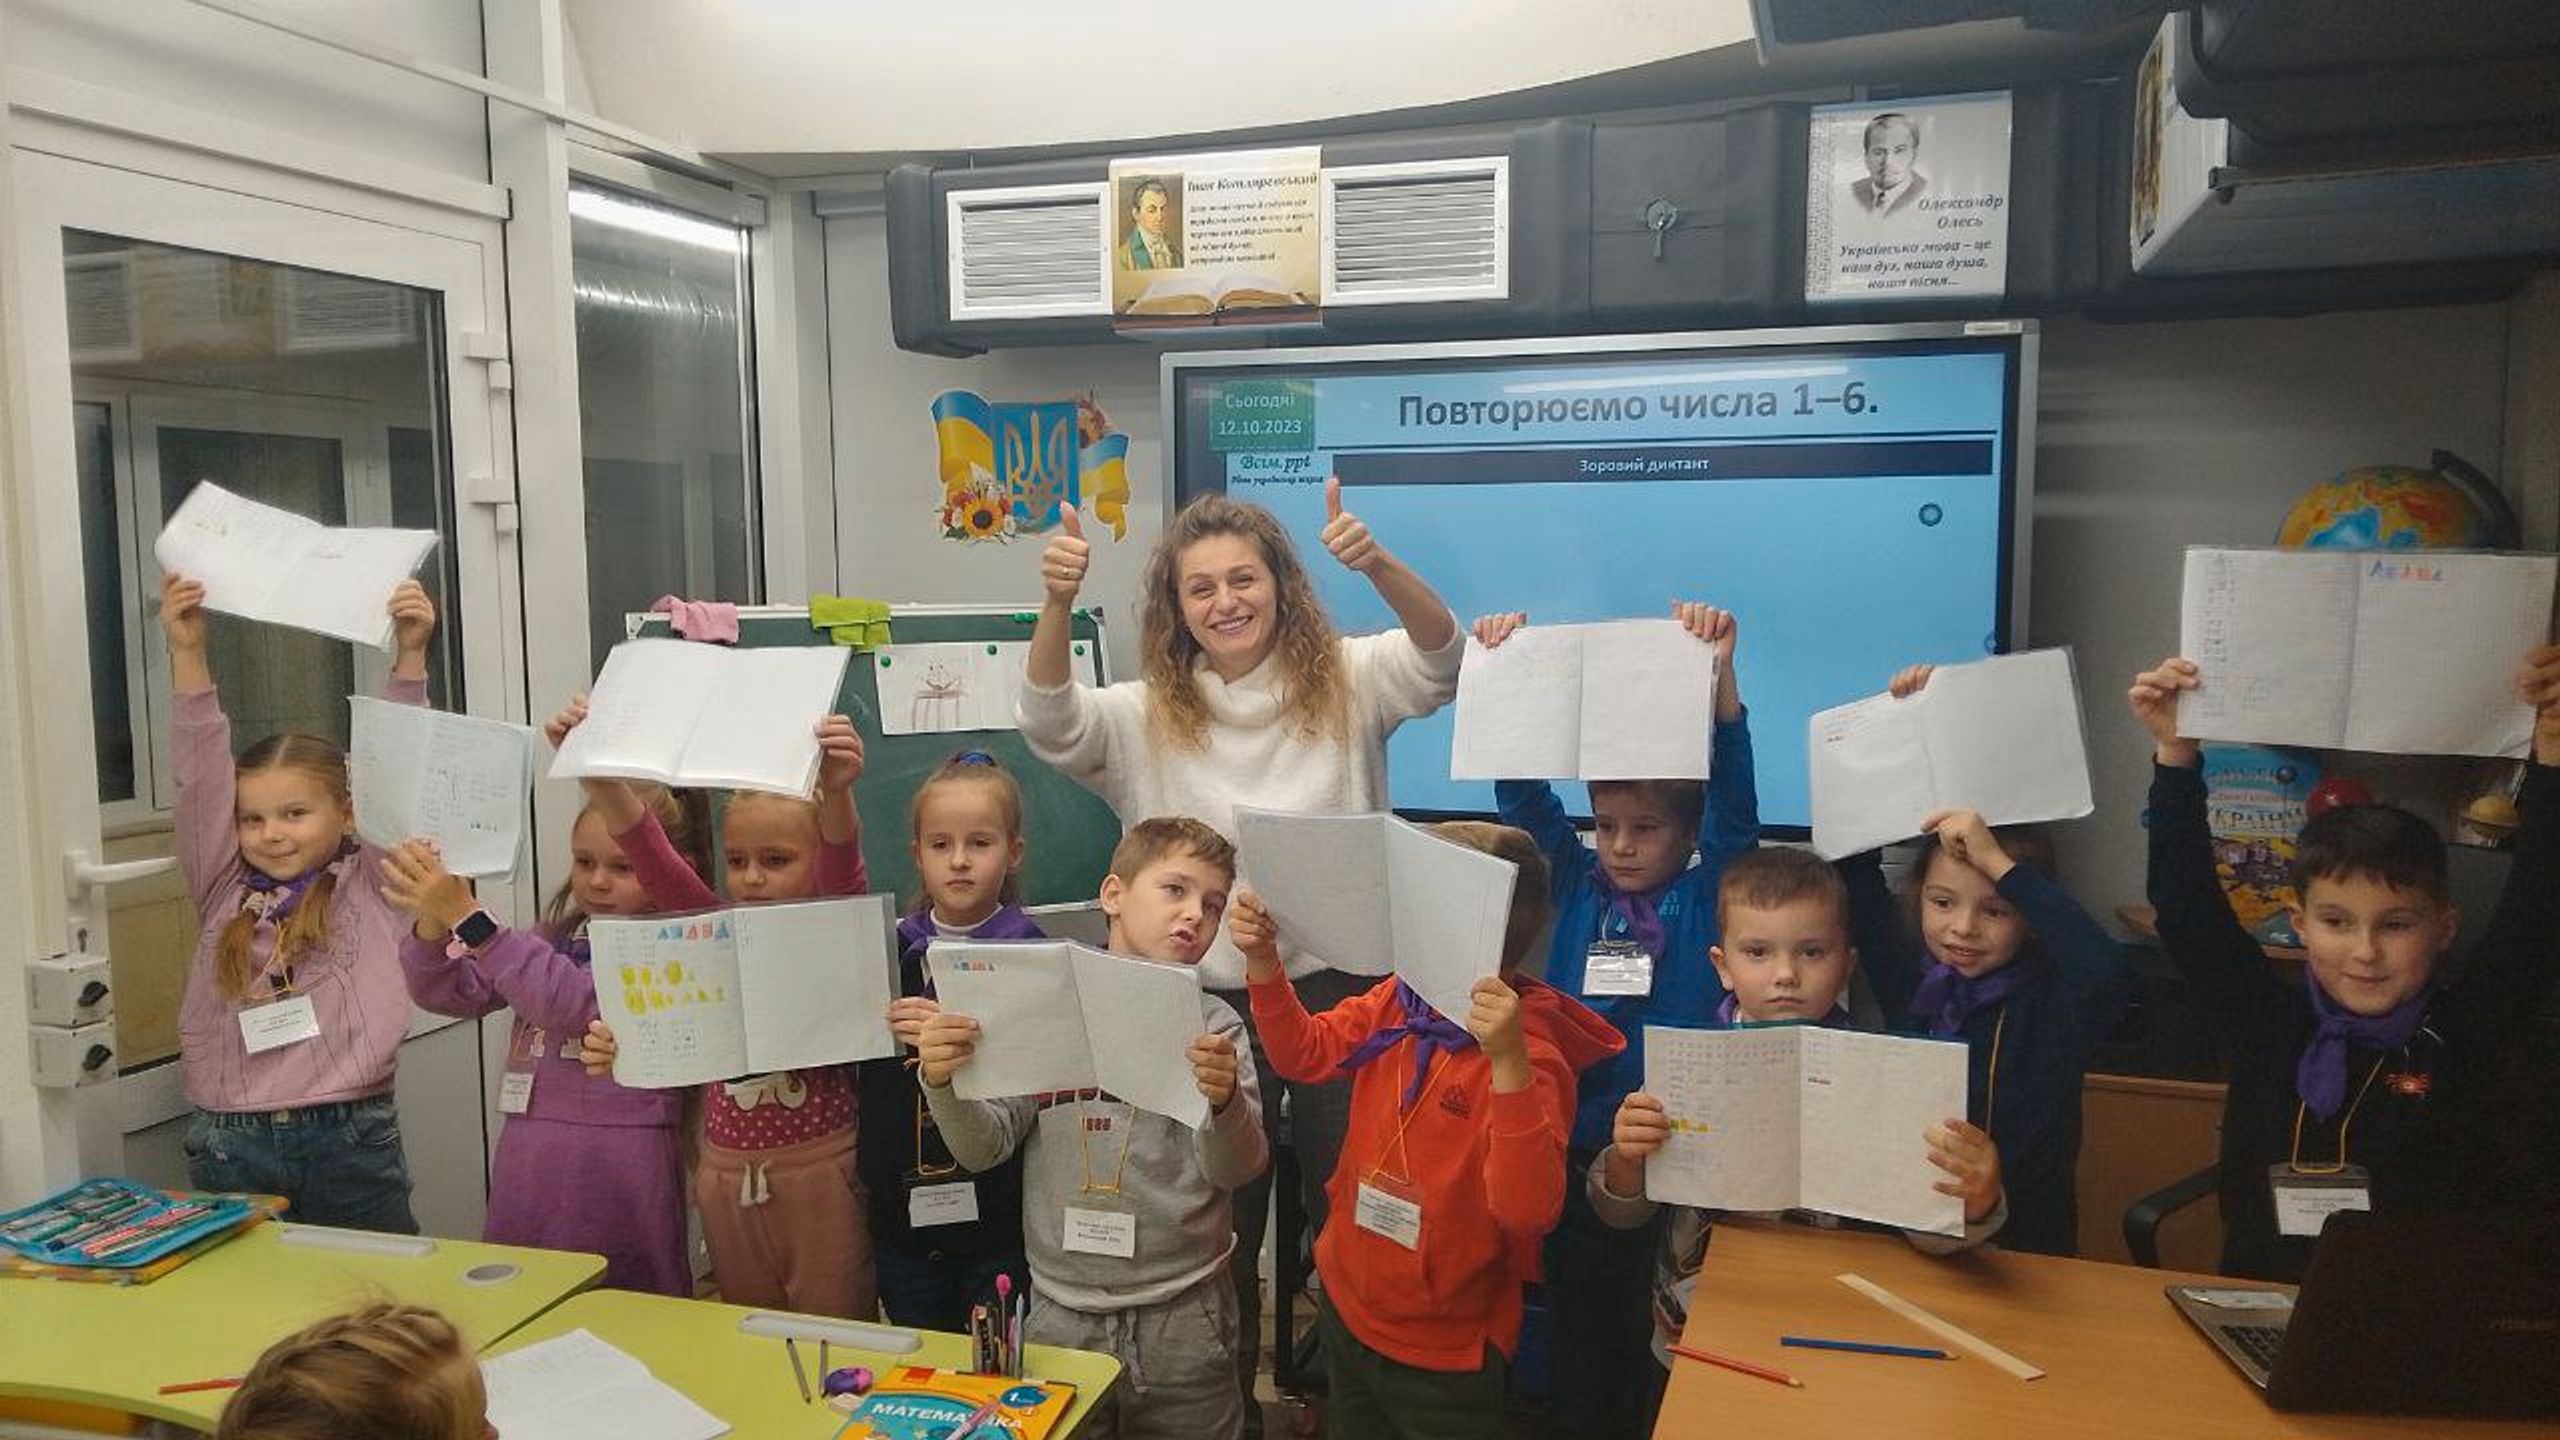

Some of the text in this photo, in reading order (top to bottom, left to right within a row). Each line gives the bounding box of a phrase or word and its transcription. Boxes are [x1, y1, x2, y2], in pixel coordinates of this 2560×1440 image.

[1918, 194, 2004, 211] Олександр
[1937, 216, 1984, 229] Олесь
[1840, 242, 1920, 257] Українська
[1921, 242, 1961, 252] мова
[1974, 240, 1992, 252] це
[1841, 263, 1871, 274] наш
[1903, 259, 1944, 271] наша
[1226, 392, 1295, 409] Сьогодні
[1400, 393, 1647, 431] Повторюємо
[1660, 390, 1778, 419] числа
[1219, 419, 1302, 436] 12.10.2023
[1579, 457, 1710, 475] Зоровий диктант
[872, 1402, 1022, 1428] МАТЕМАИКА
